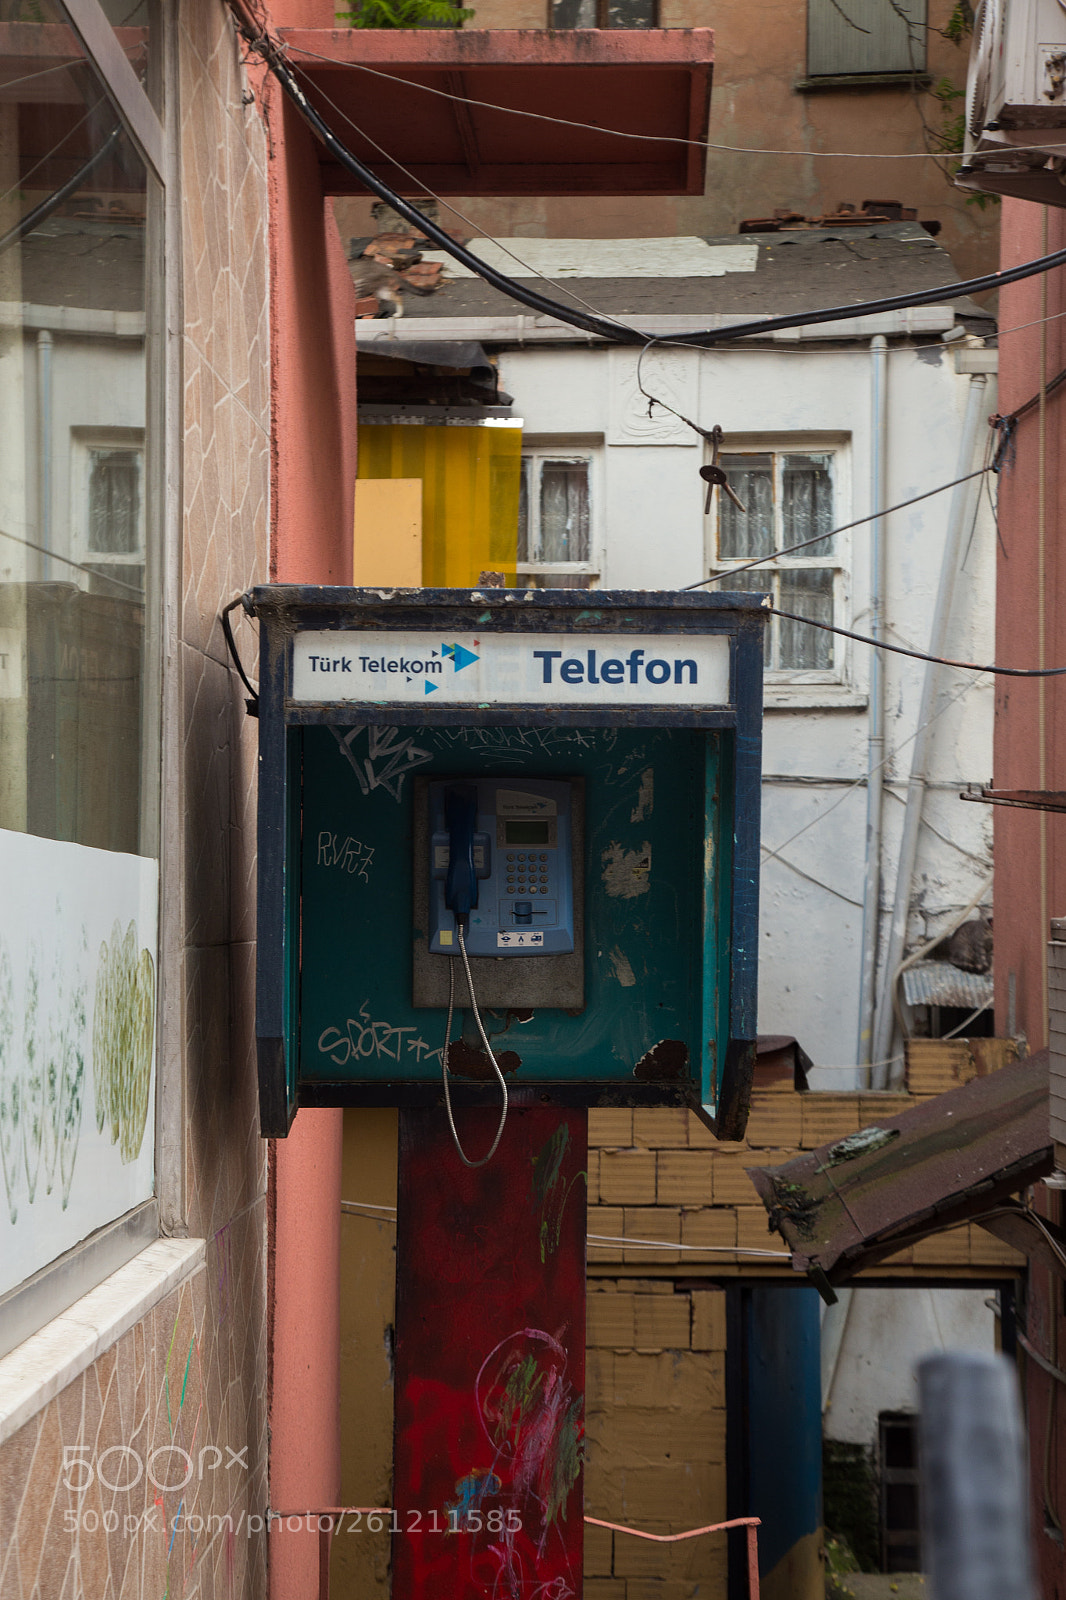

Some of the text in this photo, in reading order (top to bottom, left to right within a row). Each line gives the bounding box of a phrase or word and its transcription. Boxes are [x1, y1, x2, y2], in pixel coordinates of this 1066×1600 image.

[308, 655, 442, 674] Türk Telekom
[533, 649, 698, 684] Telefon
